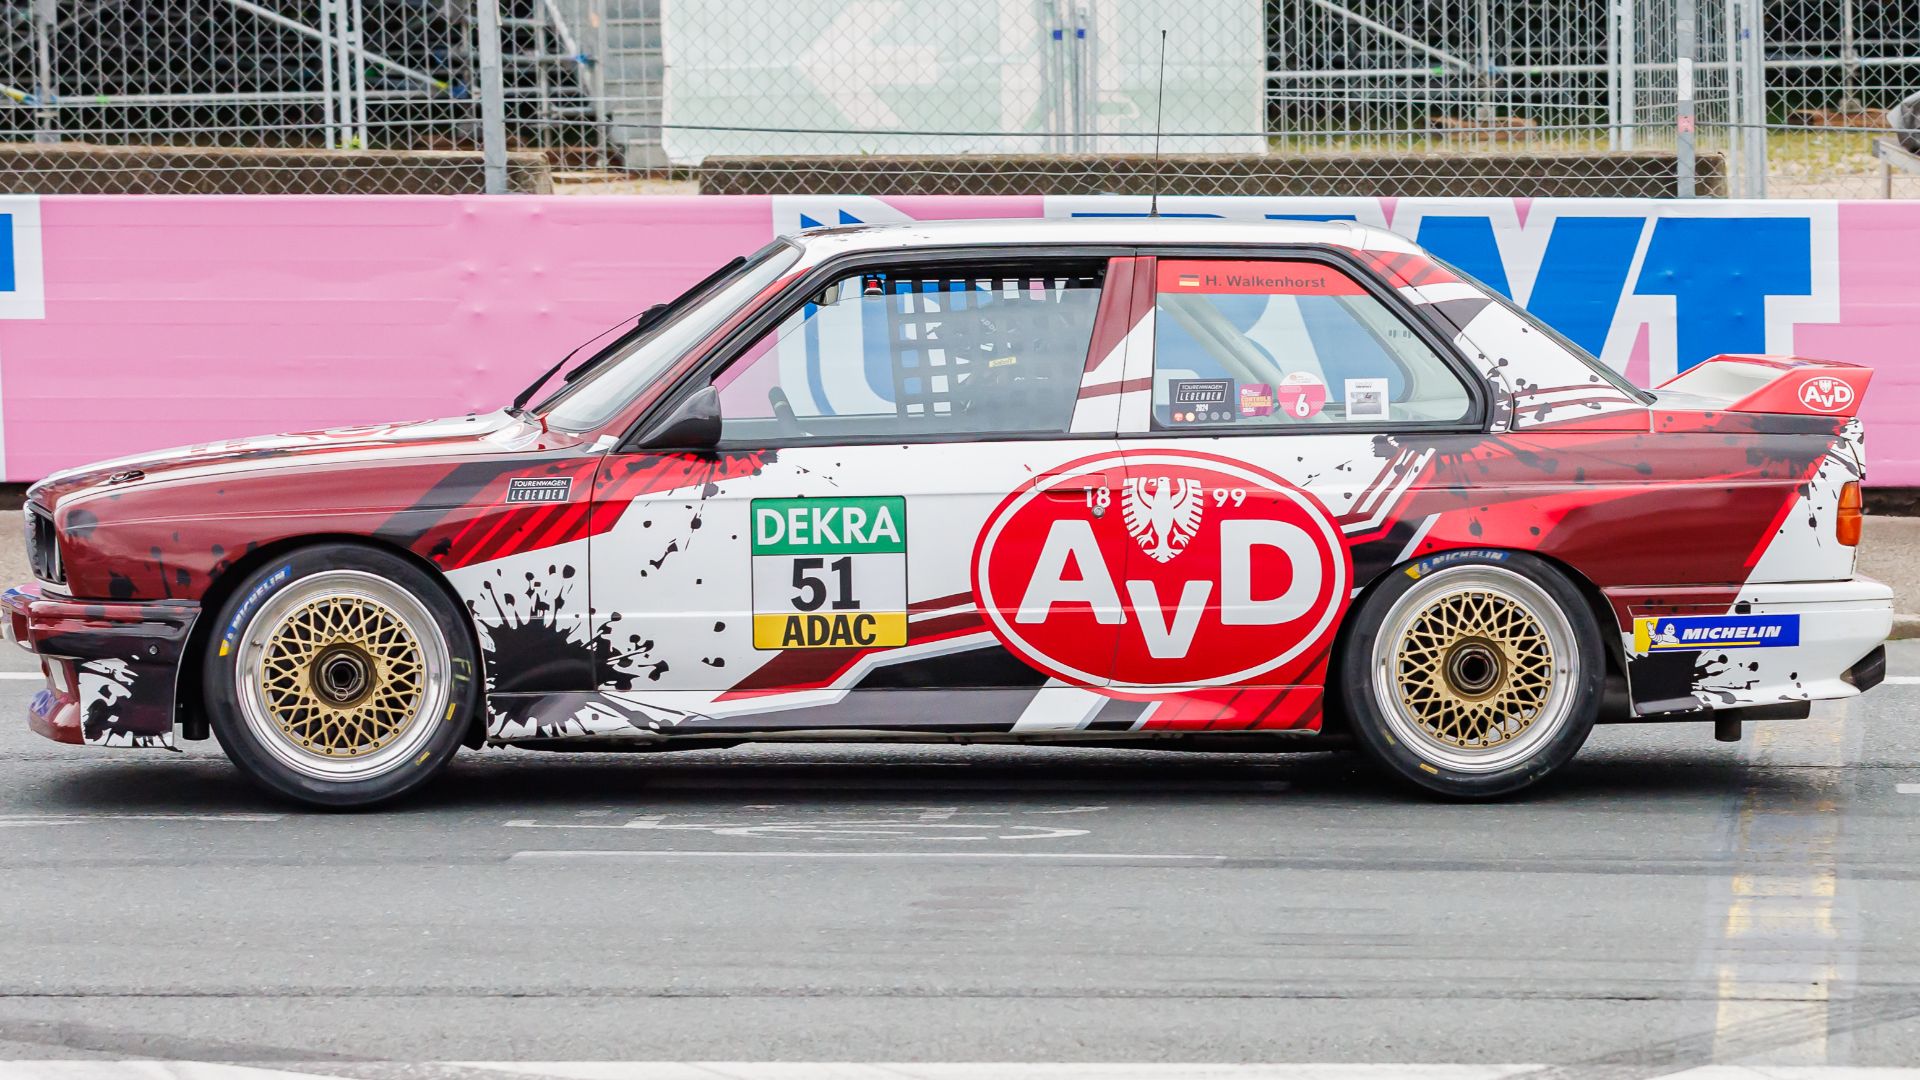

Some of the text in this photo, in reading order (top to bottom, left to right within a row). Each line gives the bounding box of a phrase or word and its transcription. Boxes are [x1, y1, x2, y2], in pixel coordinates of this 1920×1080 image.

[1205, 274, 1326, 288] H. Walkenhorst
[1179, 391, 1222, 401] LEGENDEN
[1295, 393, 1310, 417] 6
[511, 489, 565, 501] LEGENDEN
[1083, 486, 1247, 508] 18 99
[756, 505, 901, 546] DEKRA
[1432, 550, 1504, 565] MICHELIN
[790, 556, 861, 612] 51
[781, 613, 877, 647] ADAC
[1681, 625, 1782, 641] MICHELIN
